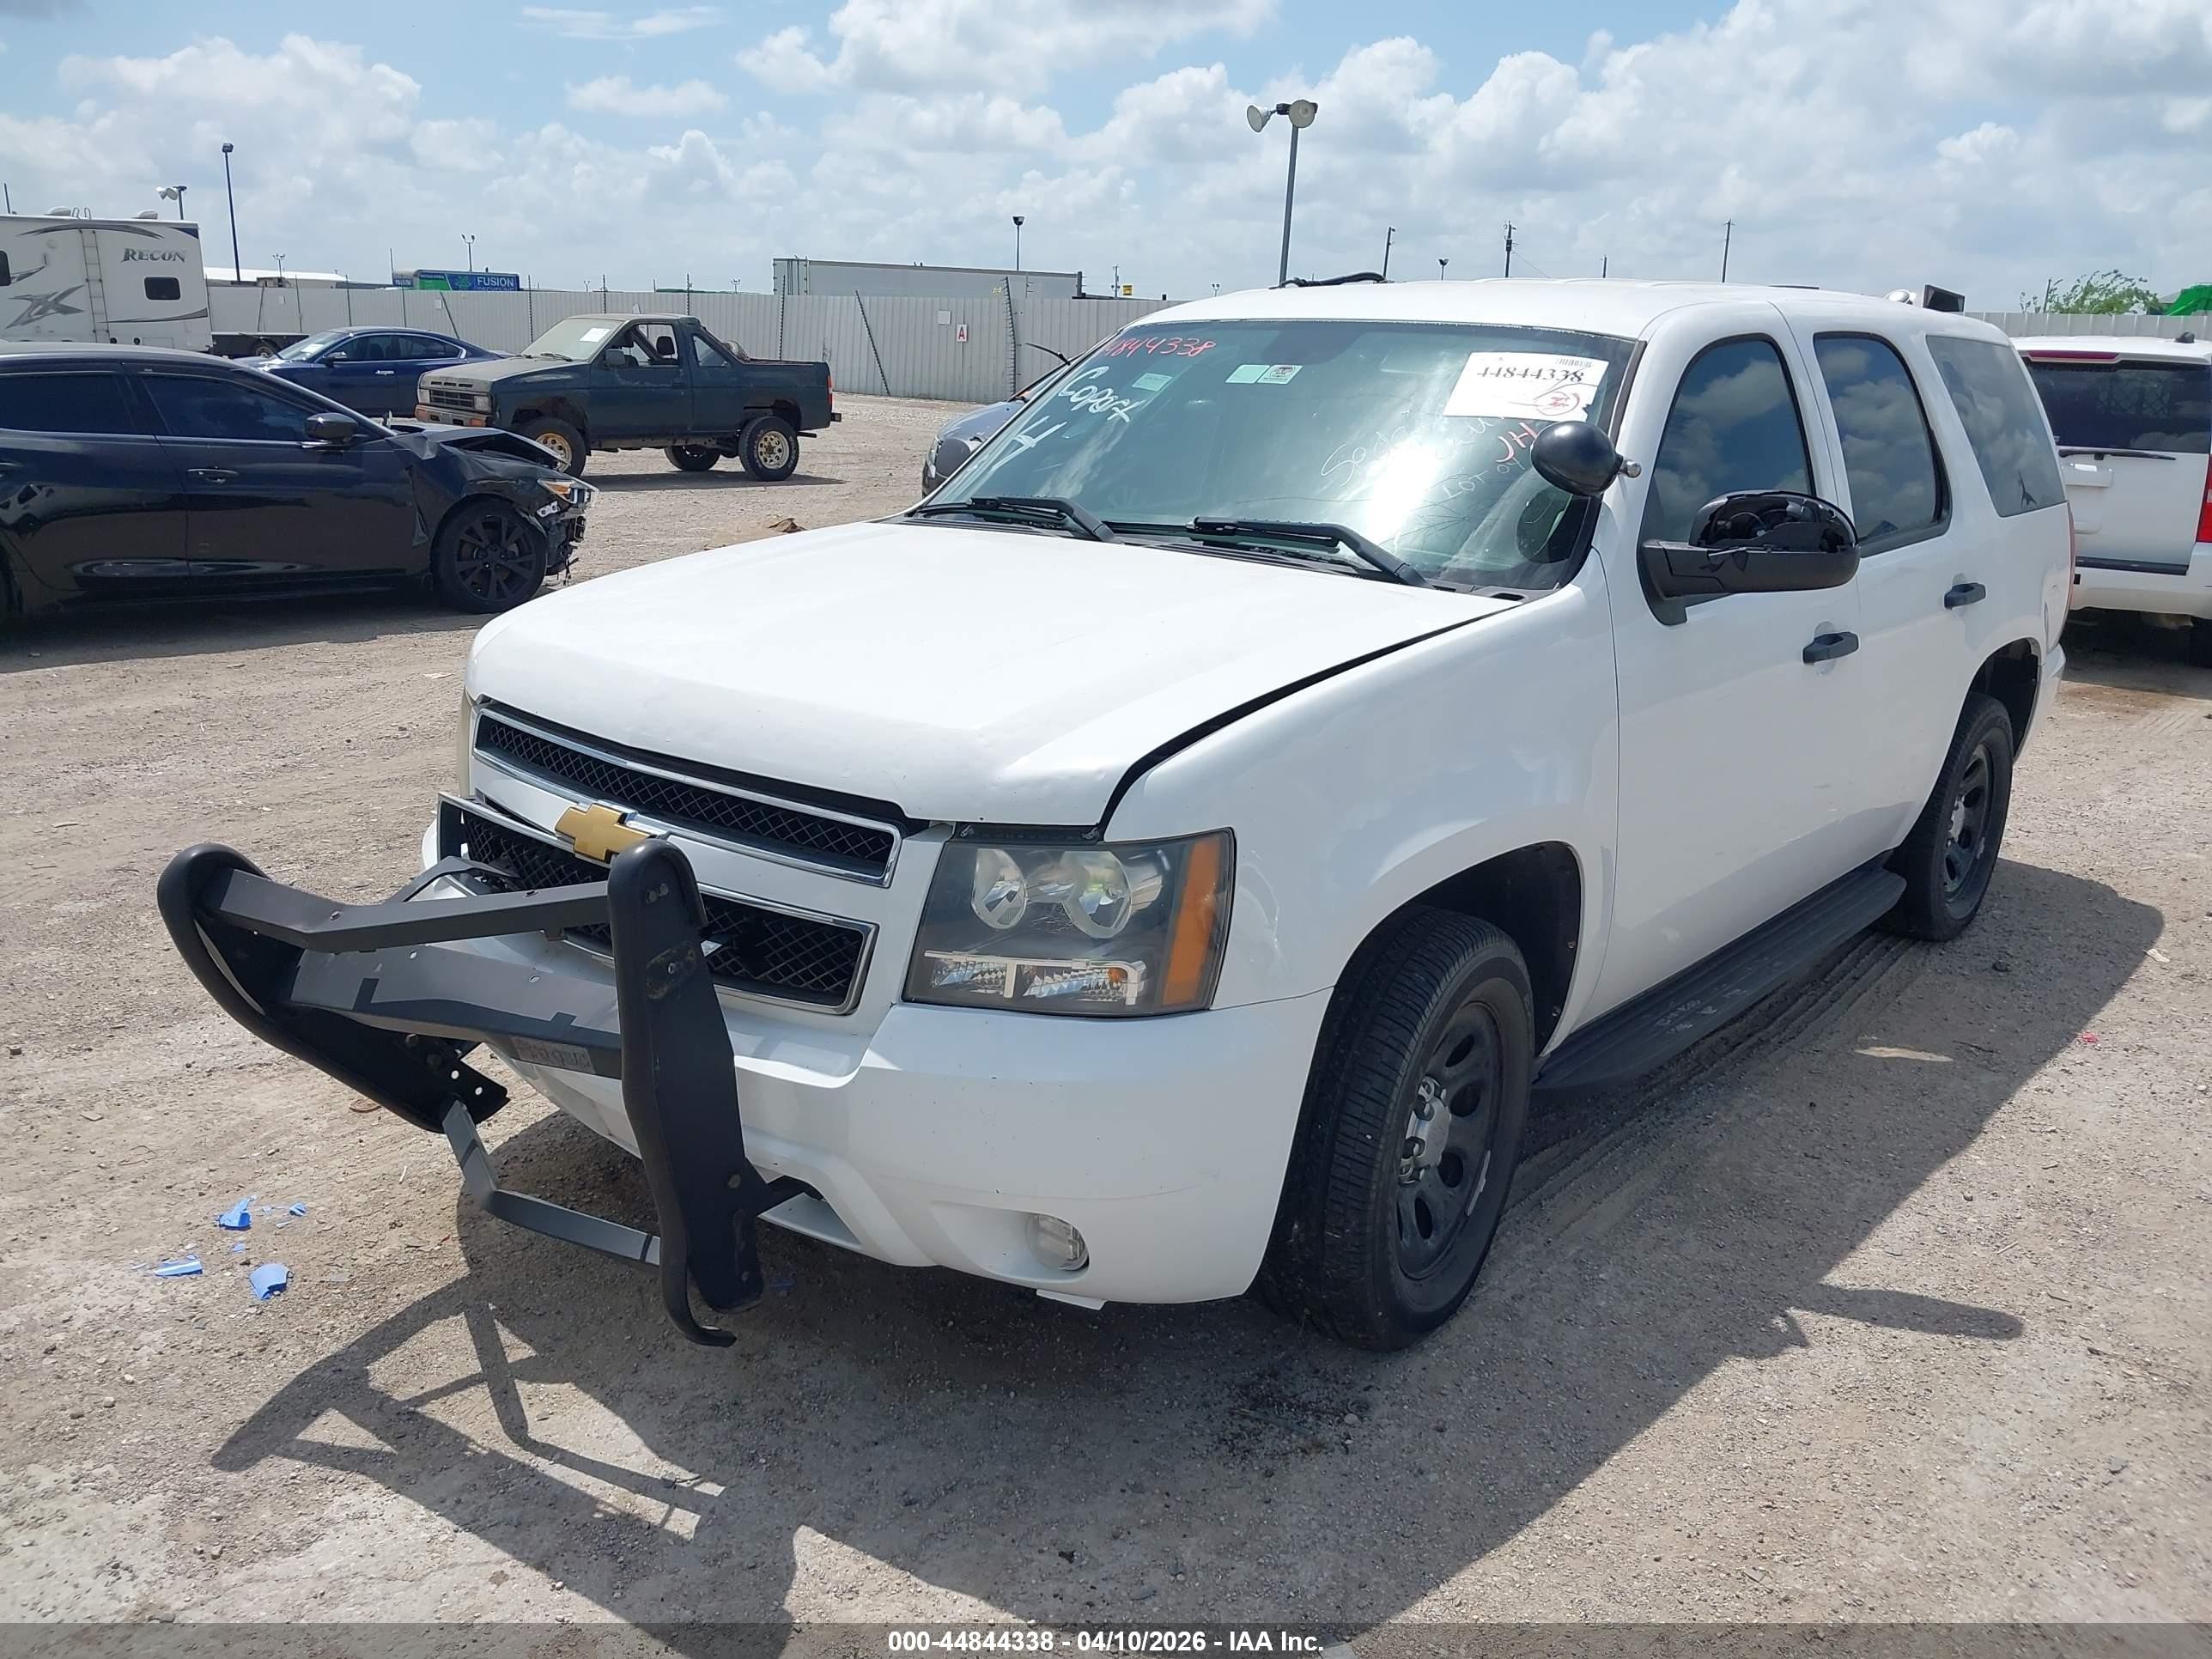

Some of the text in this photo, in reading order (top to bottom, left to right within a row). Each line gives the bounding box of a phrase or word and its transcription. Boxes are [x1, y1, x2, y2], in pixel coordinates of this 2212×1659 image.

[121, 247, 188, 263] RECON
[477, 276, 514, 287] FUSION
[958, 326, 965, 340] A
[1476, 366, 1584, 383] 44844338
[1058, 366, 1146, 422] Copart
